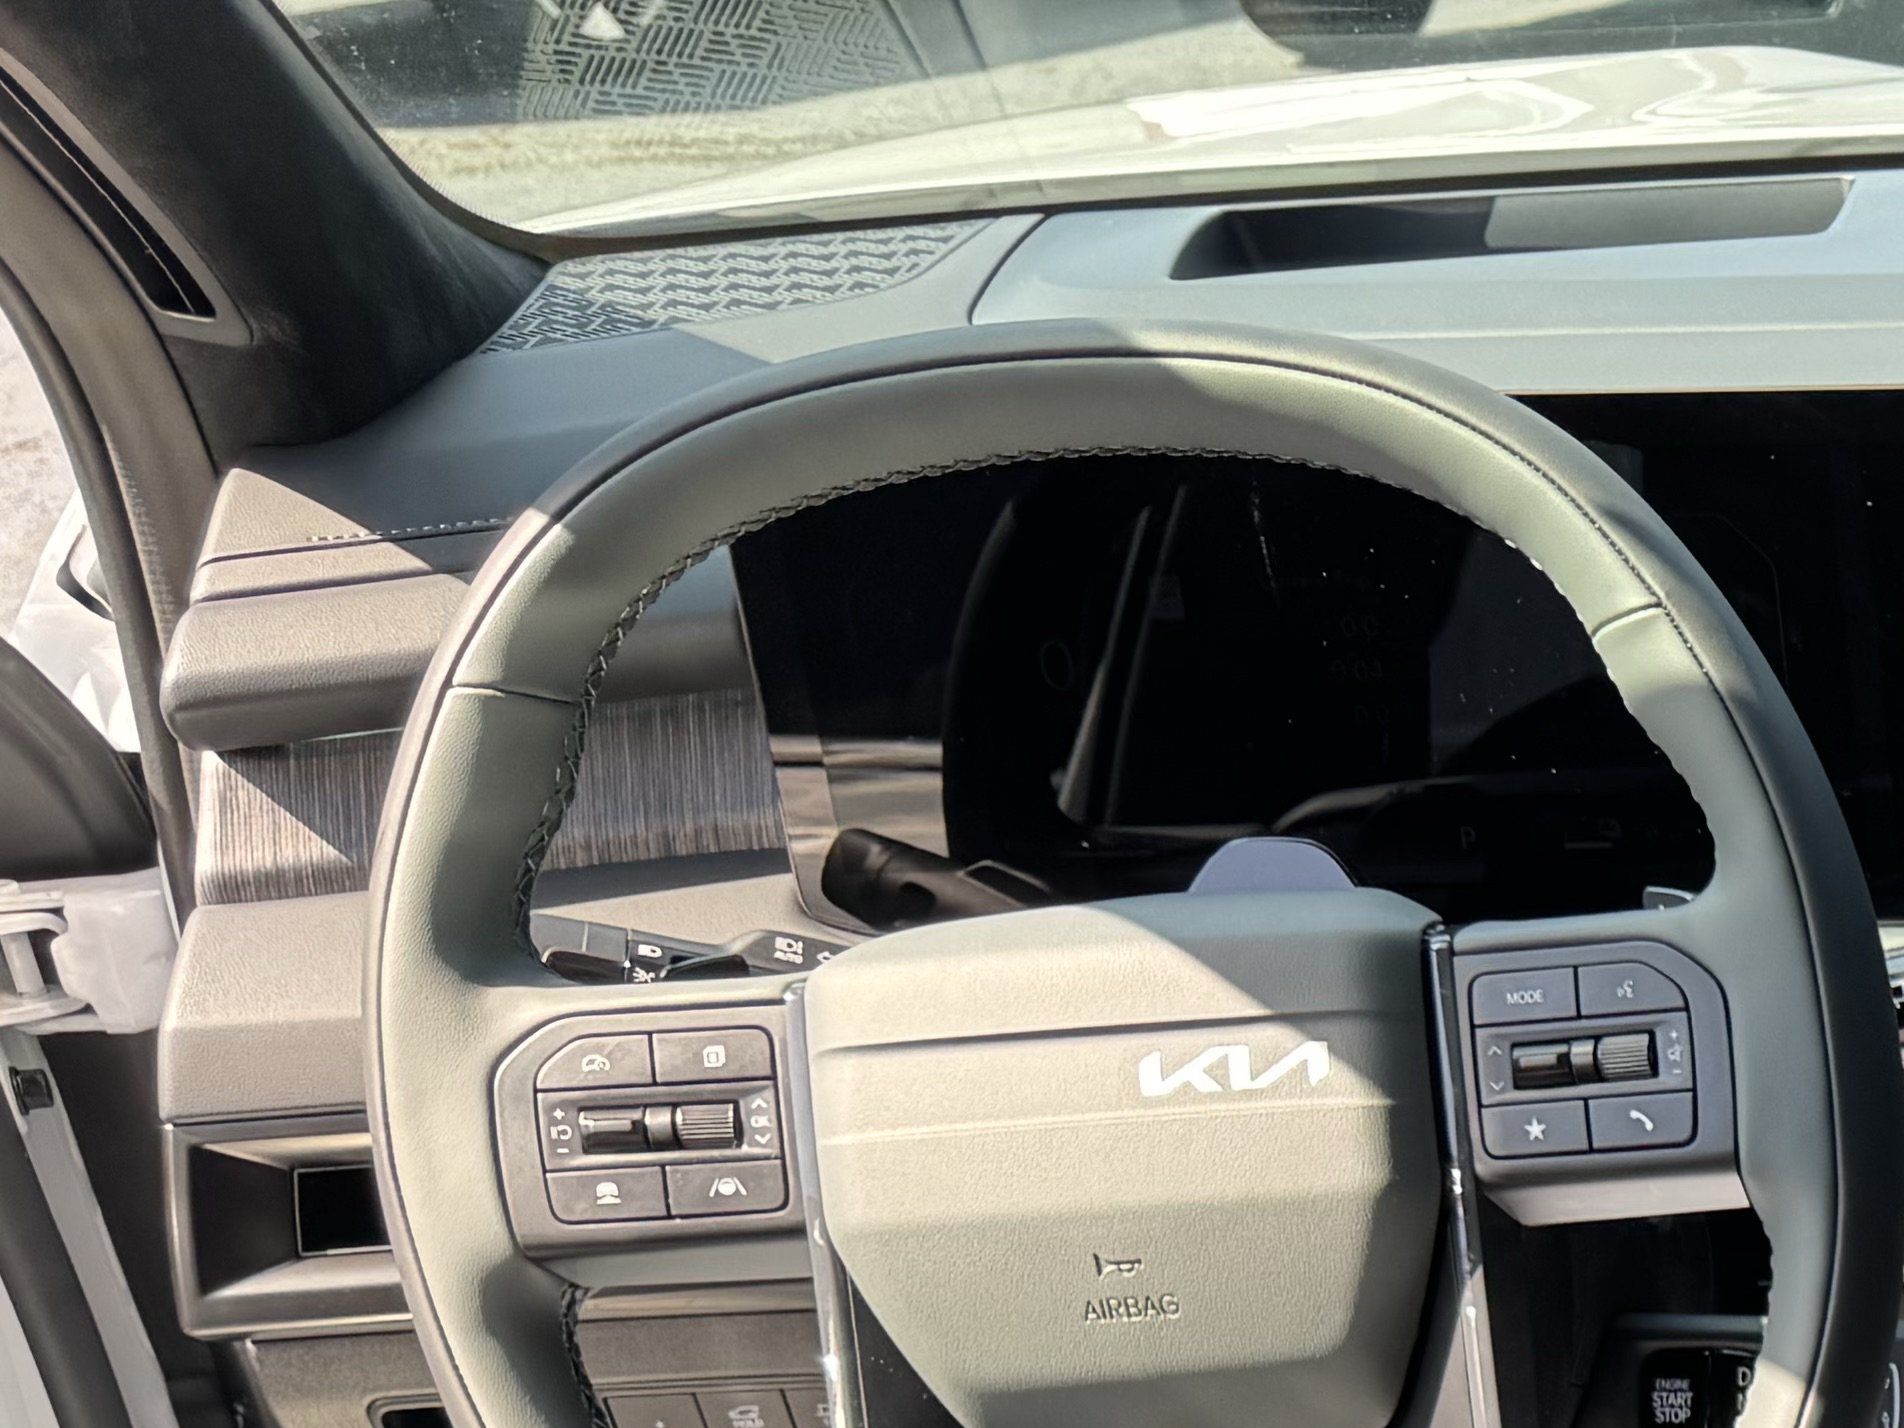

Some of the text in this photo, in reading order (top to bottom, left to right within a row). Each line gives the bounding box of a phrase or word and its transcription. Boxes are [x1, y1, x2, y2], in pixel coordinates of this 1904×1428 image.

[1506, 989, 1544, 1005] MODE
[1138, 1040, 1331, 1098] KIA
[1084, 1293, 1180, 1322] AIRBAG
[1651, 1391, 1693, 1407] START
[1654, 1407, 1691, 1424] STOP
